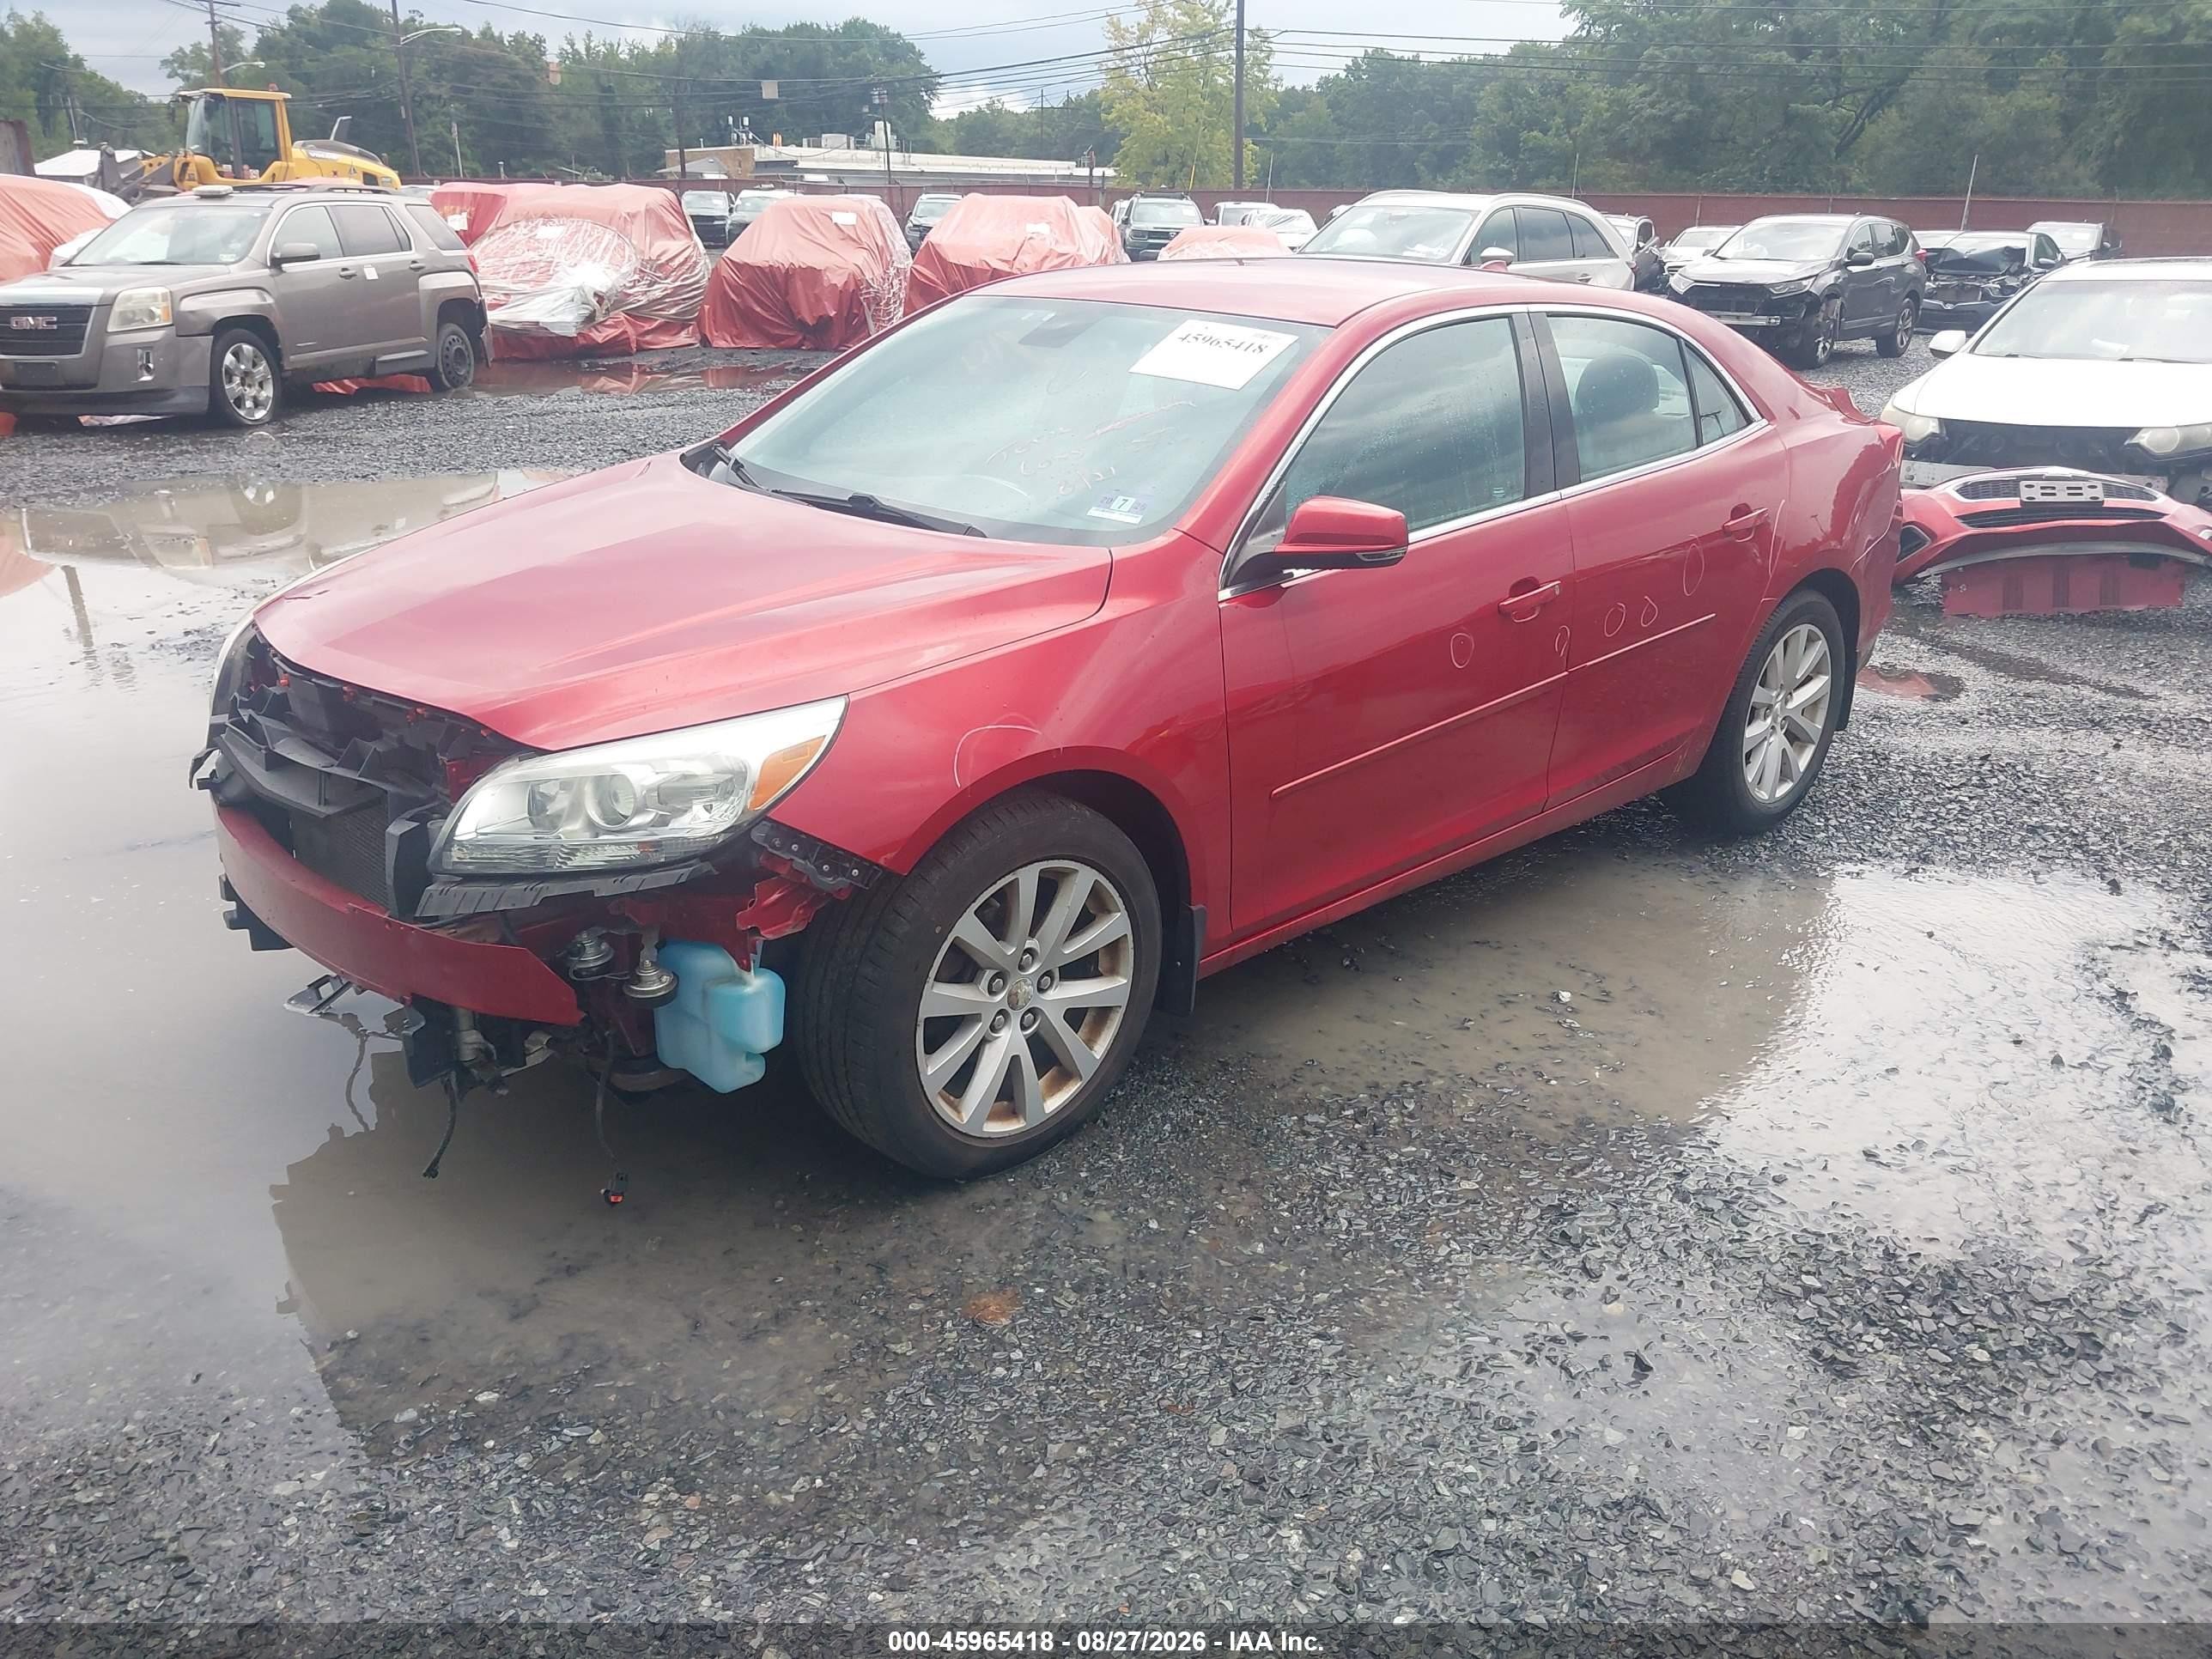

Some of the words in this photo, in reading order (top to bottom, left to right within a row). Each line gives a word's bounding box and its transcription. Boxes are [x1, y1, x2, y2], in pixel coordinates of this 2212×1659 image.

[10, 316, 58, 330] GMC
[1177, 332, 1269, 354] 45965418
[1118, 498, 1128, 509] 7
